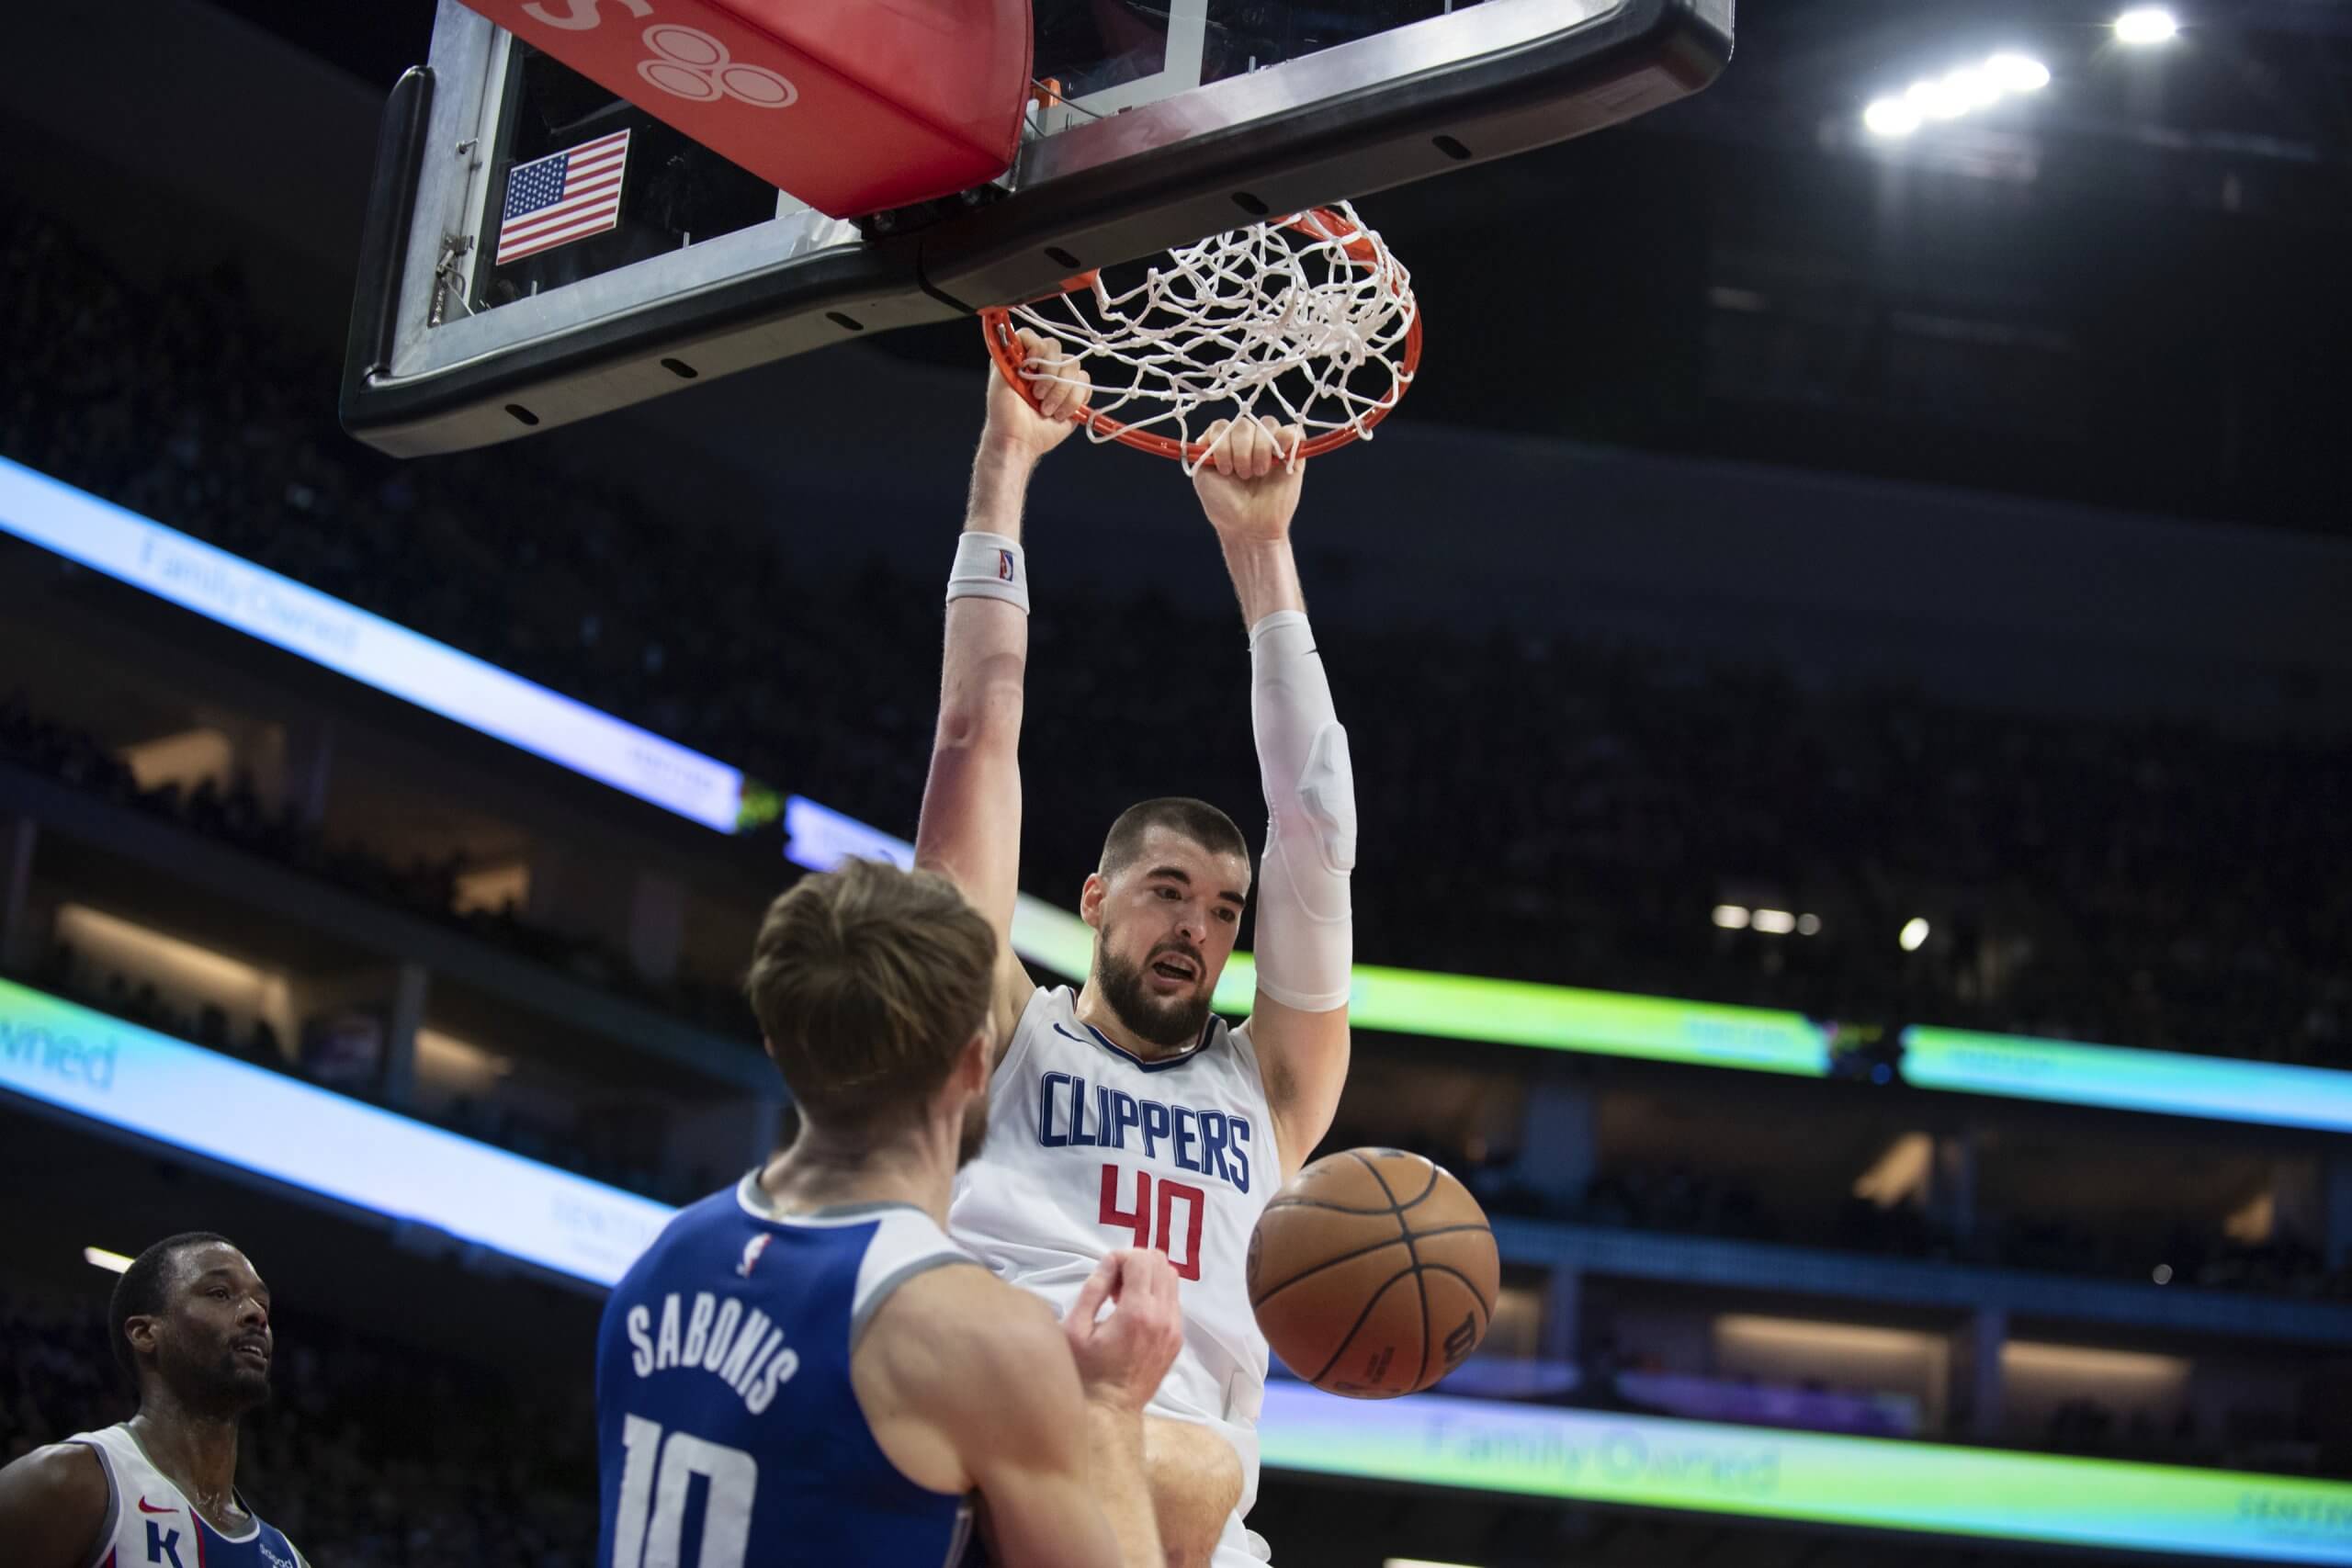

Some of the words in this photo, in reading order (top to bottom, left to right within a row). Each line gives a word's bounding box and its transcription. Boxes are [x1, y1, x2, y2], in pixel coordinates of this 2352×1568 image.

[1039, 1071, 1250, 1194] CLIPPERS
[1099, 1163, 1204, 1281] 40
[627, 1292, 799, 1416] SABONIS
[613, 1413, 758, 1568] 10
[1423, 1409, 1584, 1483] Family
[1595, 1427, 1781, 1496] Owned
[145, 1519, 185, 1568] K
